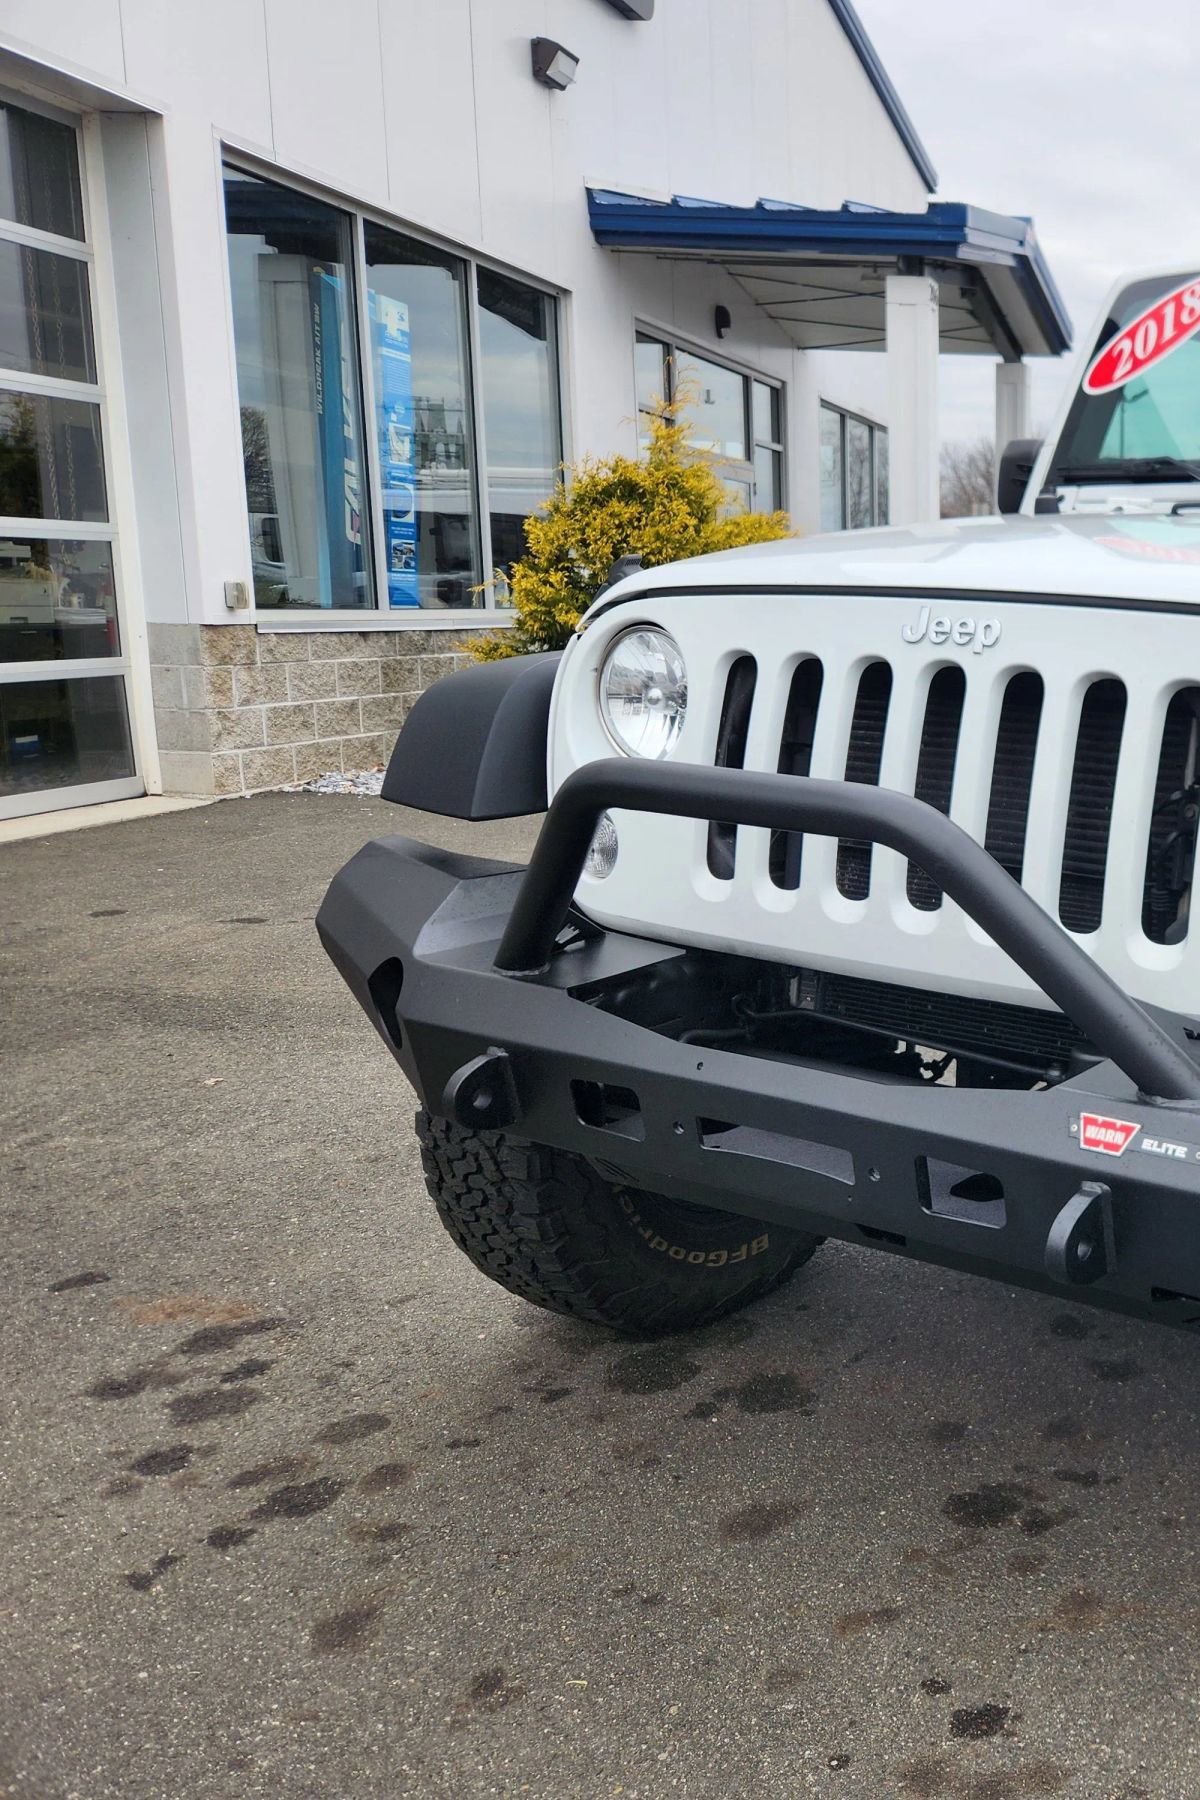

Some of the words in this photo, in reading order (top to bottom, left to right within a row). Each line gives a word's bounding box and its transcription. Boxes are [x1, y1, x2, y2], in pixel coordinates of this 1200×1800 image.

[314, 348, 324, 415] WILDPEAK
[902, 606, 1001, 655] Jeep
[1085, 1125, 1126, 1146] WARN
[1141, 1138, 1188, 1159] ELITE
